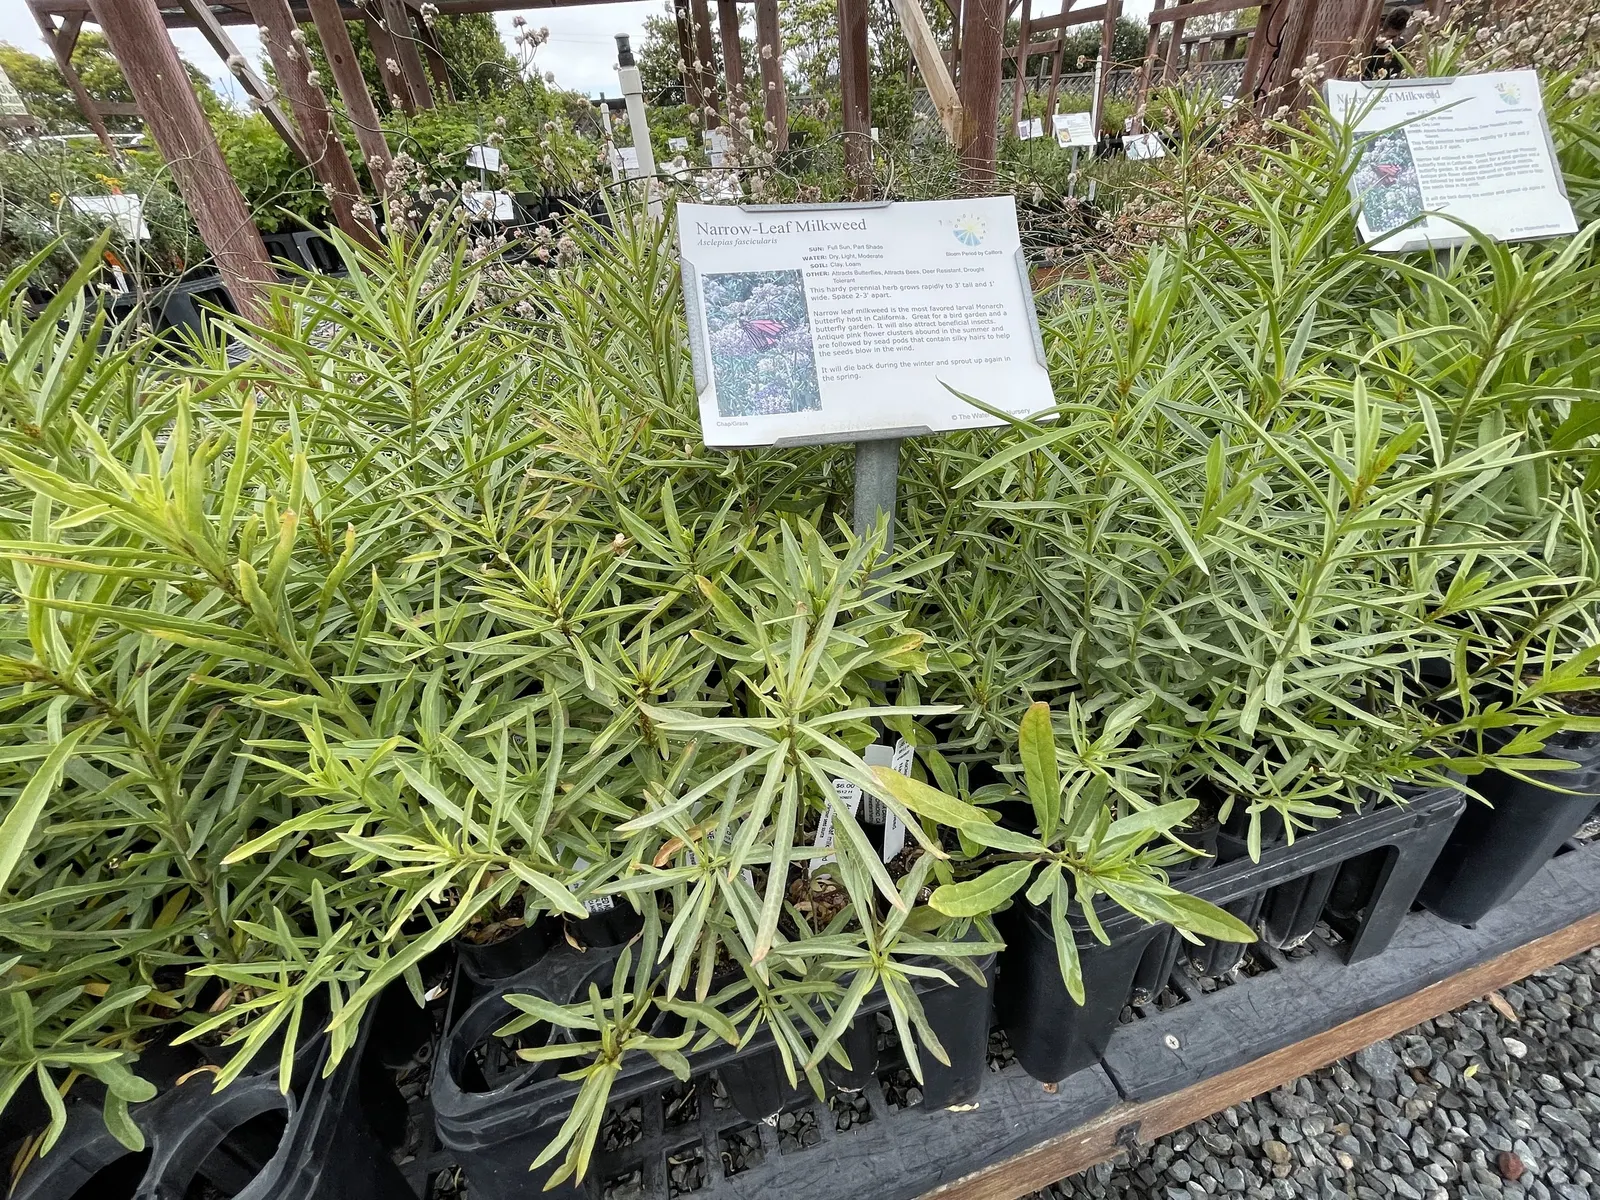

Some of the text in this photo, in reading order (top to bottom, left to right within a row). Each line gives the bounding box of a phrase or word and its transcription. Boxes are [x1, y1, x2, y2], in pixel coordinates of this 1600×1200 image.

[696, 219, 867, 236] Narrow-Leaf Milkweed
[697, 237, 778, 248] Asclepias fascicularis
[814, 317, 845, 325] butterfly
[815, 324, 846, 333] butterfly
[938, 319, 969, 327] beneficial
[817, 333, 844, 341] Antique
[831, 340, 861, 348] followed
[926, 335, 951, 343] contain
[952, 334, 968, 342] silky
[996, 332, 1011, 340] help
[833, 348, 854, 356] seeds
[951, 358, 973, 366] sprout
[984, 356, 1003, 364] again
[836, 373, 862, 381] spring.
